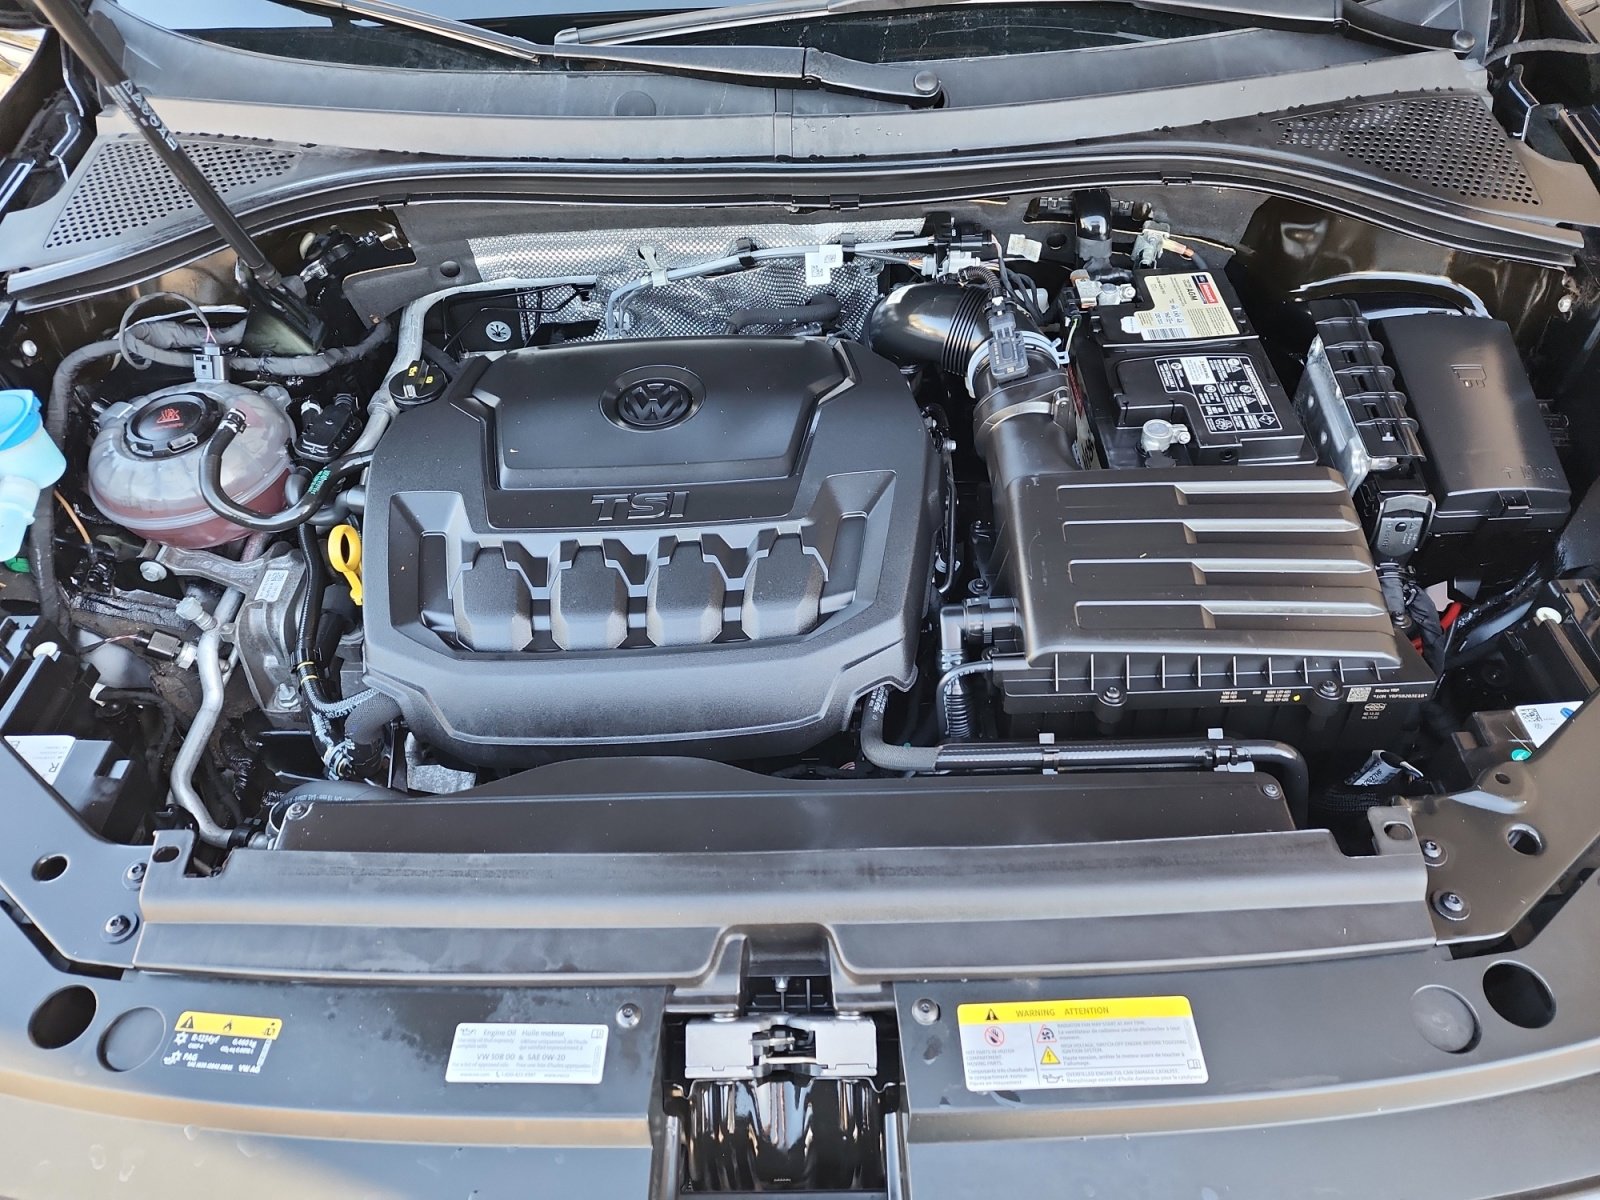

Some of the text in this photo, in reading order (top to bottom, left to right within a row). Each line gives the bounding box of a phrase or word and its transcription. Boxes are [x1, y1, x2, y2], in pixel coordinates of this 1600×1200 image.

[591, 491, 690, 521] TSI
[1015, 1006, 1110, 1018] WARNING ATTENTION
[483, 1029, 507, 1039] Engine
[507, 1028, 517, 1037] Oil
[521, 1029, 540, 1037] Huile
[477, 1053, 490, 1061] VW
